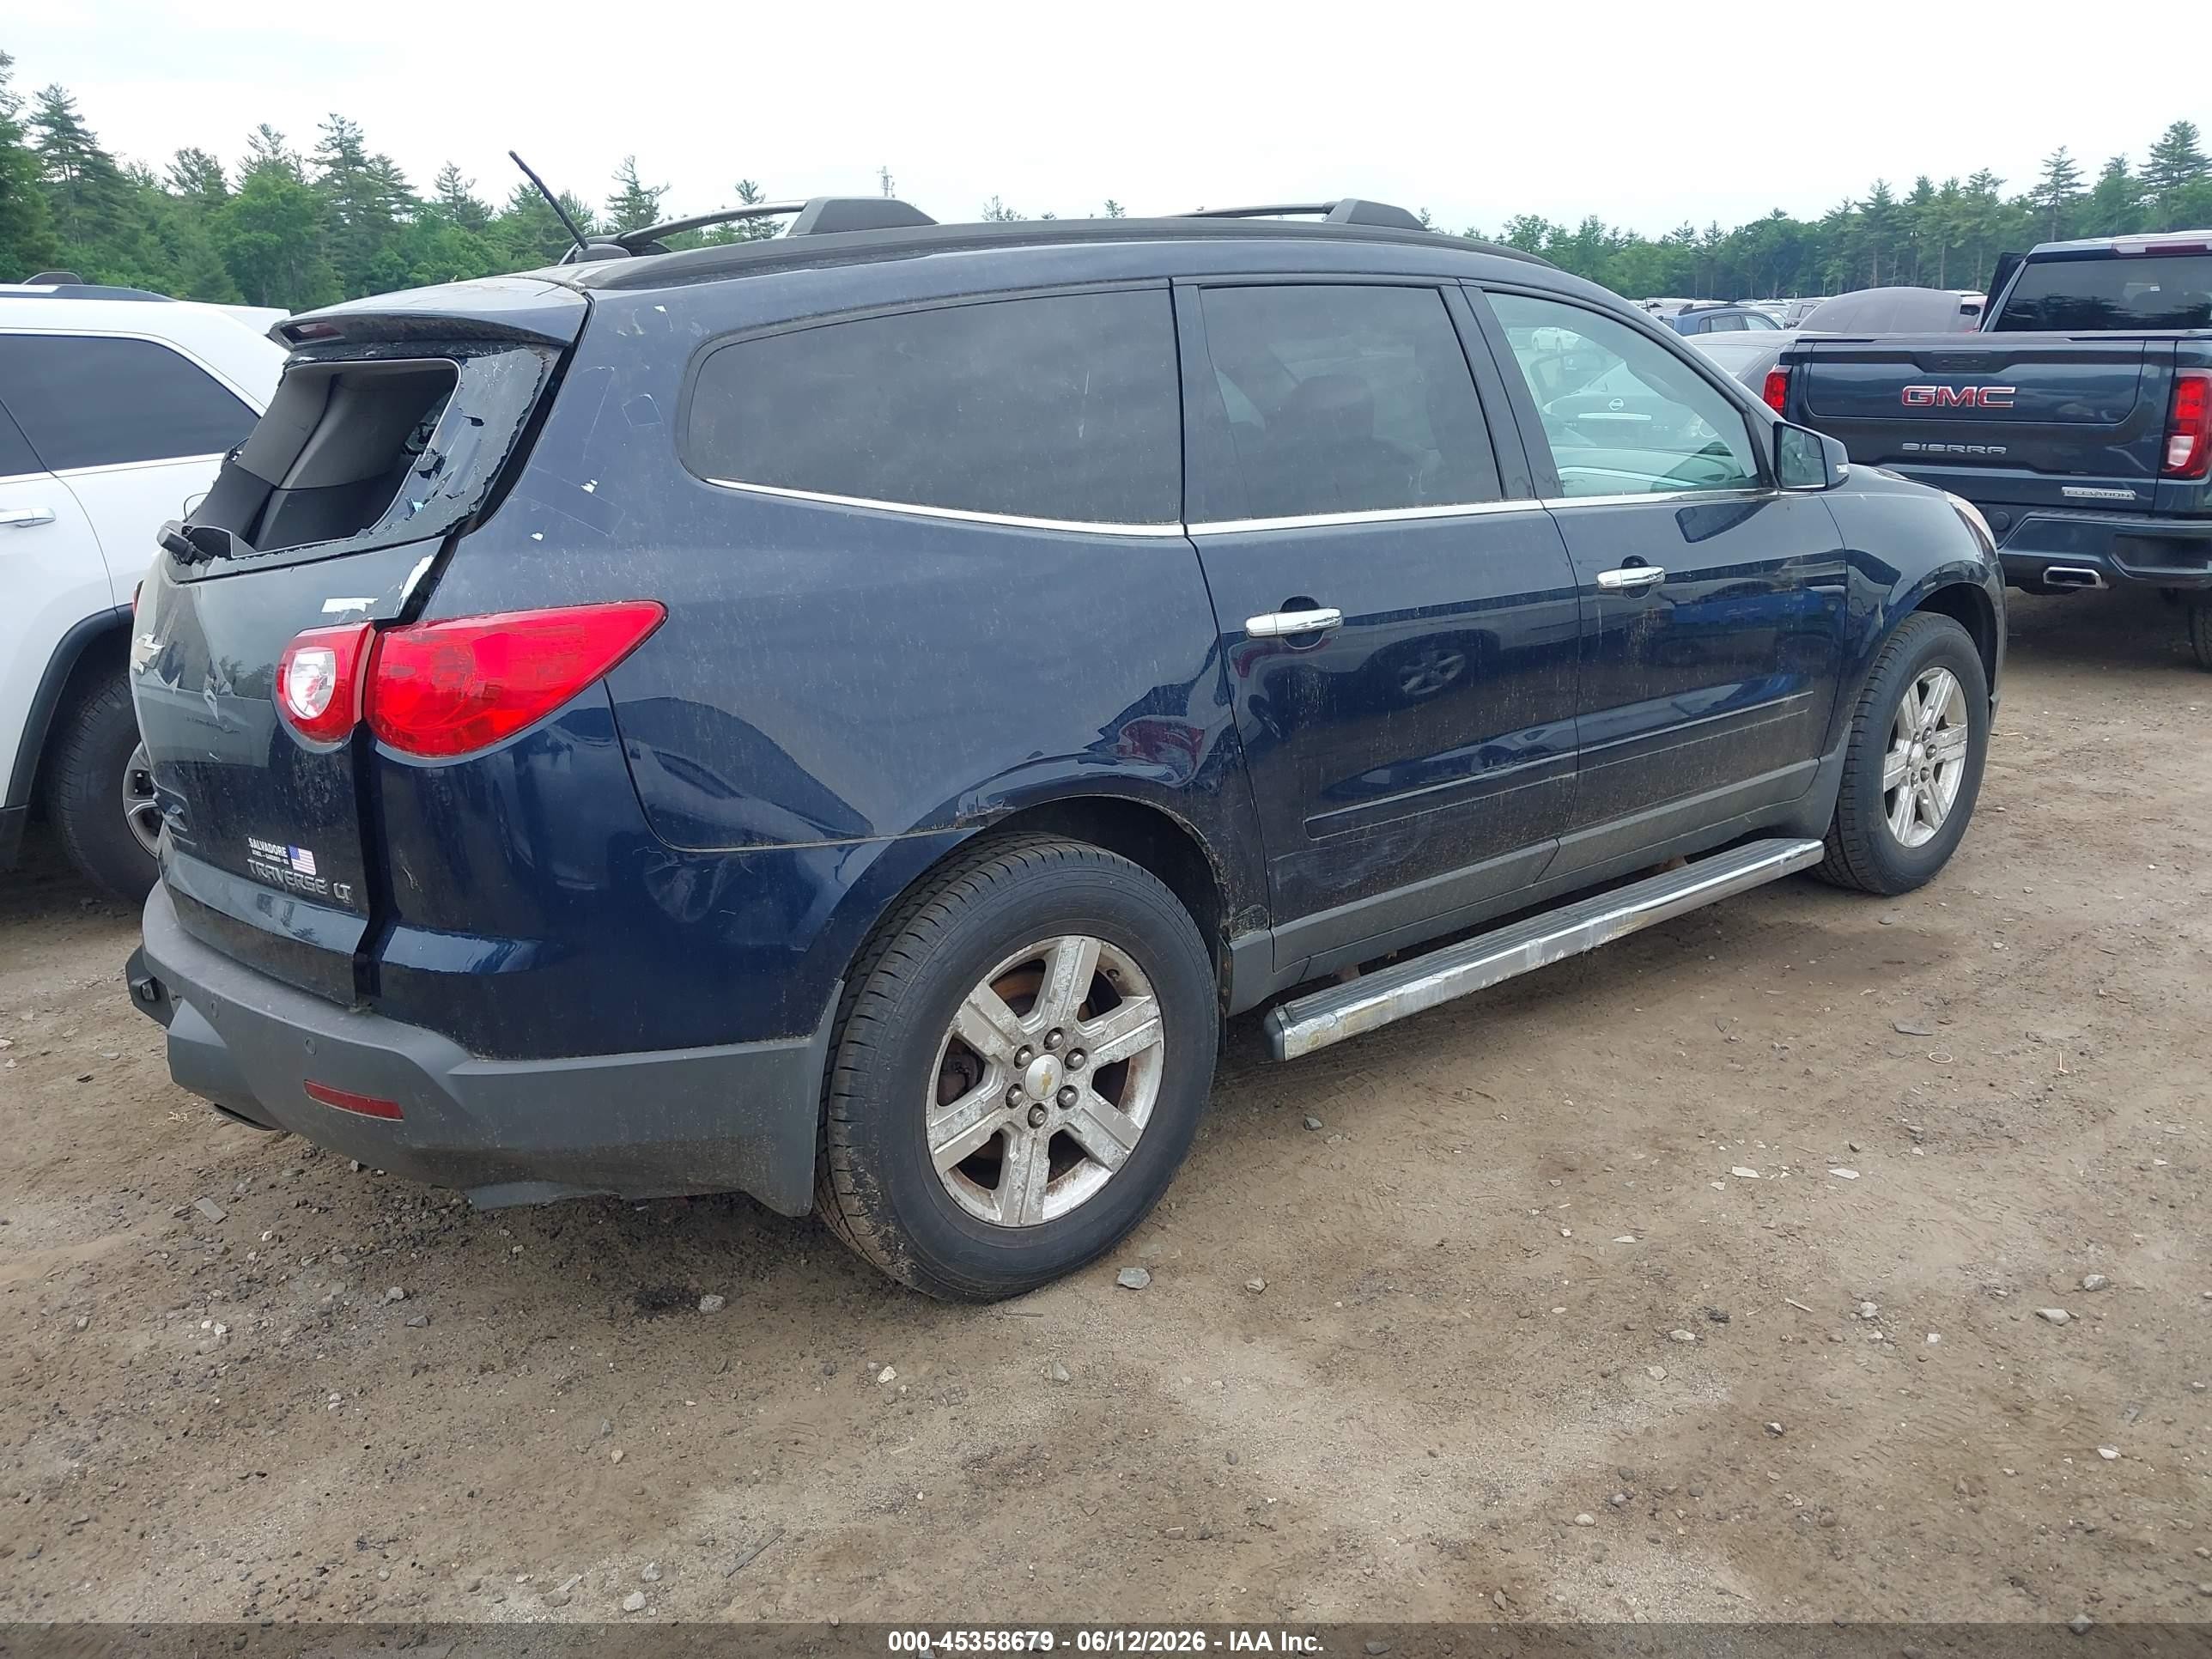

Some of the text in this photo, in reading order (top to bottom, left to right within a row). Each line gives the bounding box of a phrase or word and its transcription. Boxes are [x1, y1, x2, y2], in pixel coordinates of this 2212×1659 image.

[1902, 386, 2015, 408] GMC
[1902, 442, 2007, 454] SIERRA
[248, 836, 289, 858] SALVADORE
[247, 859, 328, 895] TRAVERSE
